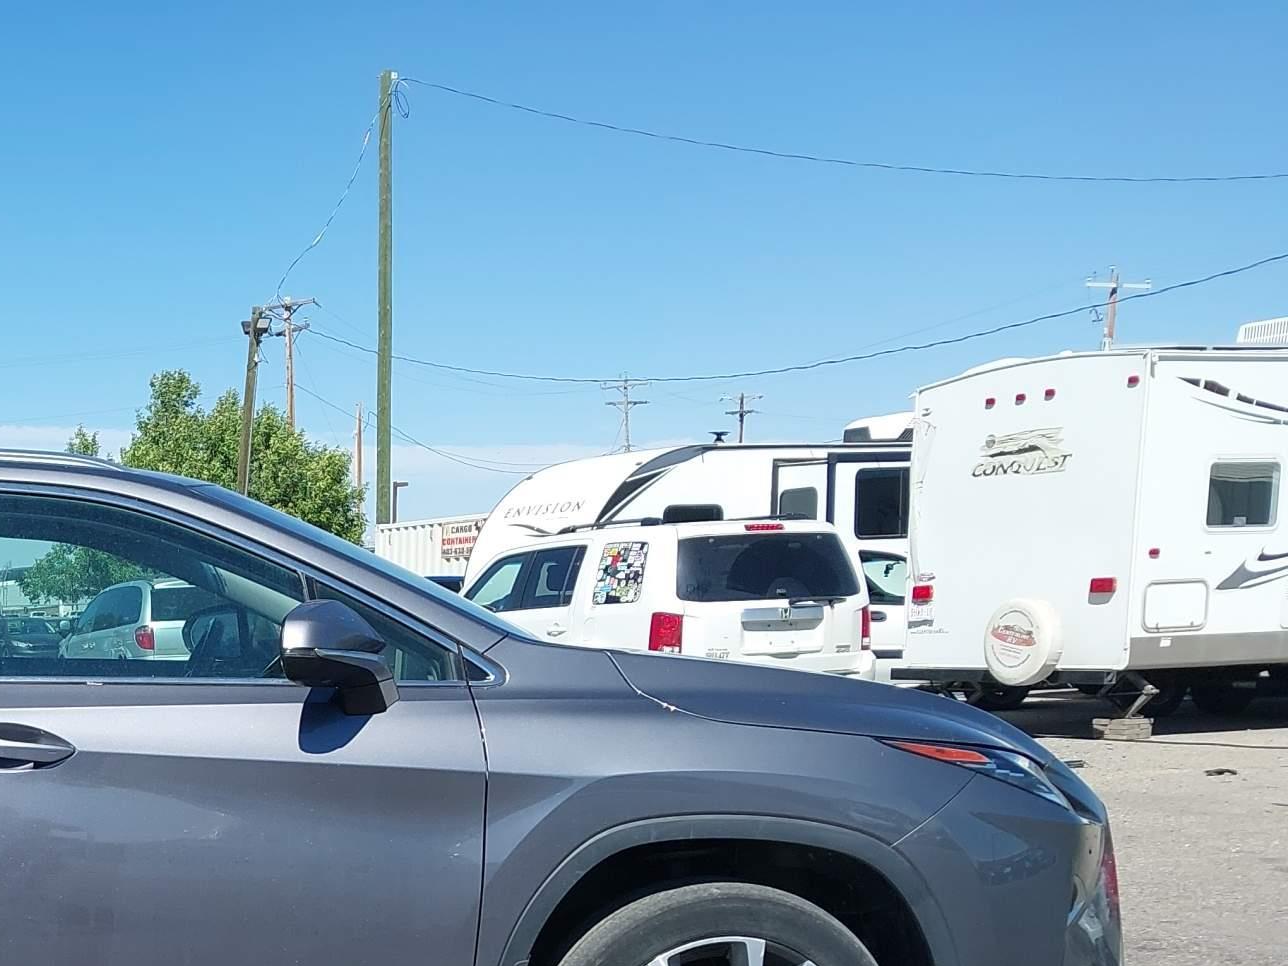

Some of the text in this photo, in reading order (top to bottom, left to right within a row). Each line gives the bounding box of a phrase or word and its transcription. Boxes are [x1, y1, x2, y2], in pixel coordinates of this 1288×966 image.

[972, 453, 1072, 478] CONQUEST
[504, 500, 586, 519] ENVISION
[451, 525, 473, 534] CARGO
